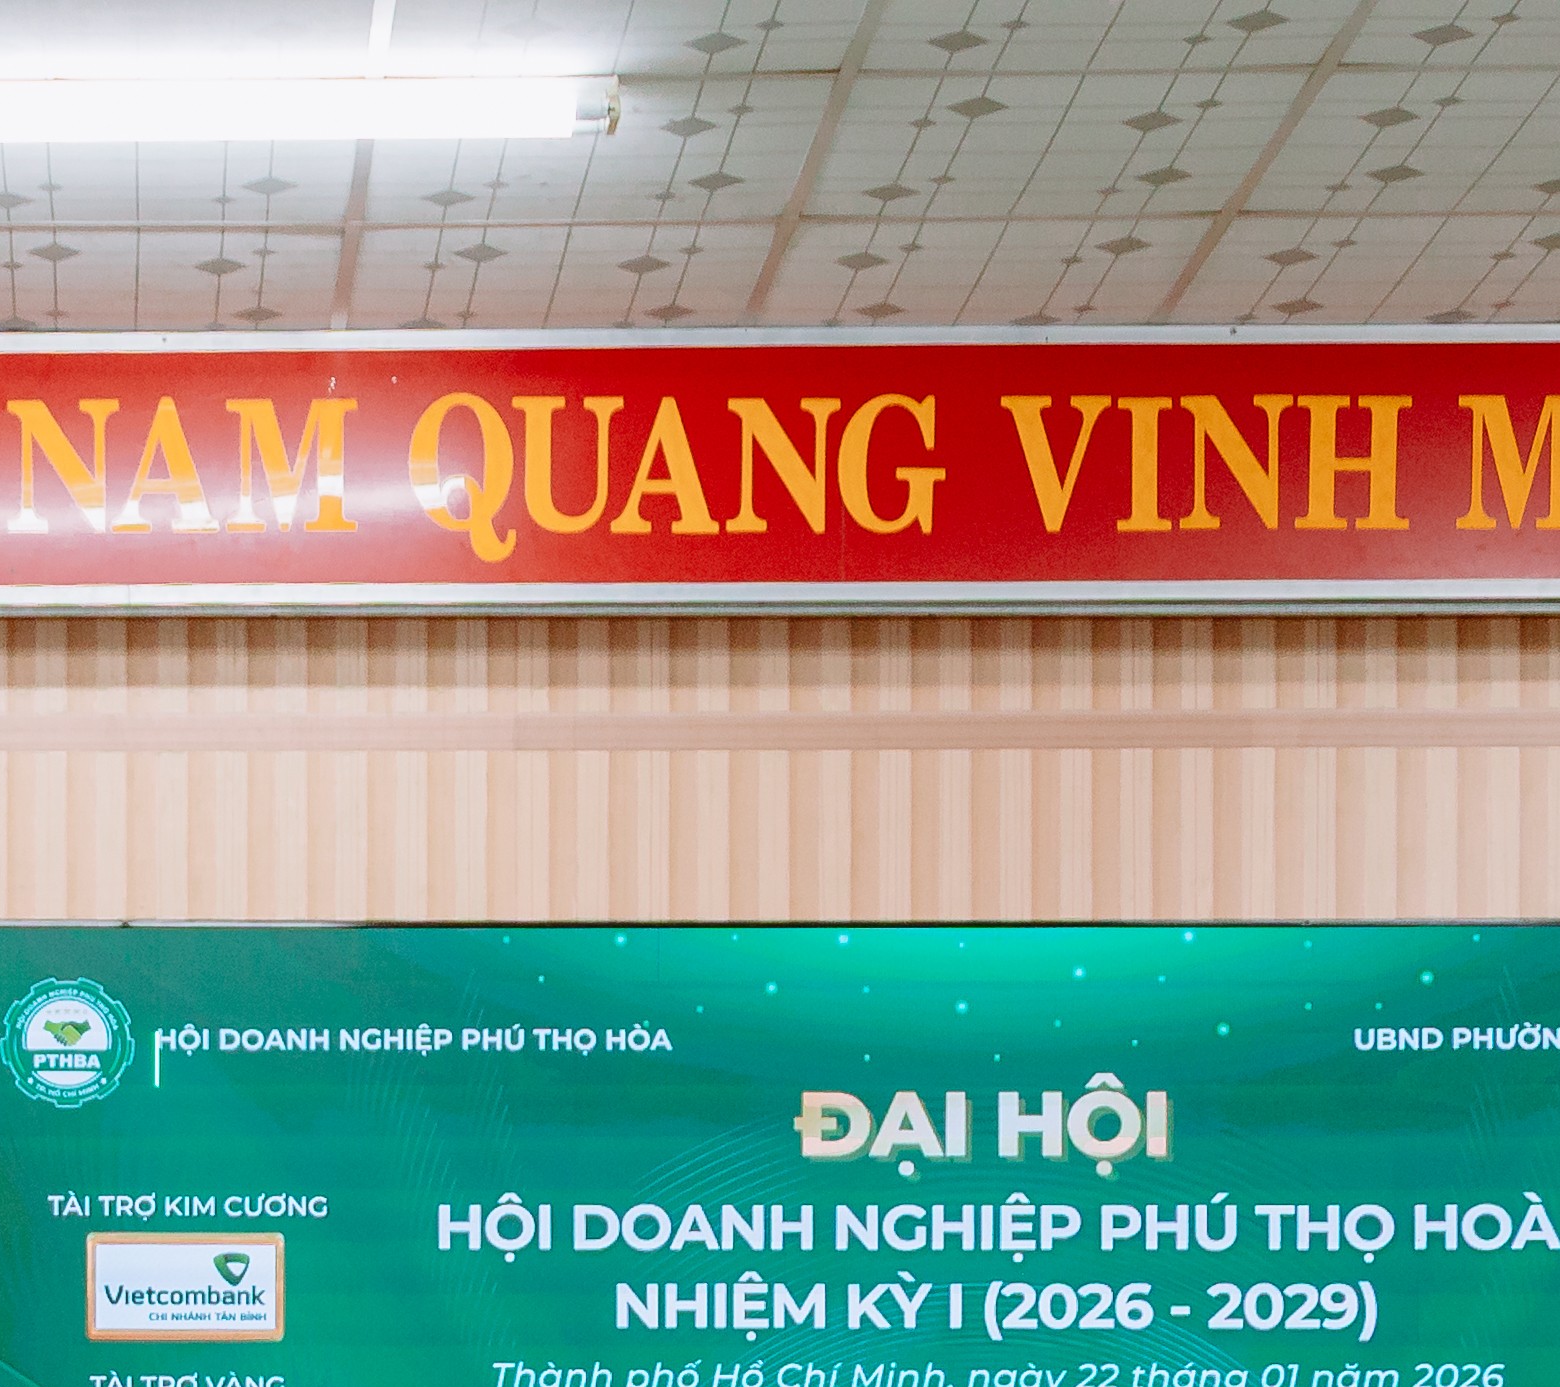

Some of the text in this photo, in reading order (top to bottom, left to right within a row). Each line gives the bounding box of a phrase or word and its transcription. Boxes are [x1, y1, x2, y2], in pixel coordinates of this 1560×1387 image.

[6, 397, 358, 536] NAM
[414, 393, 947, 563] QUANG
[1000, 394, 1410, 534] VINH
[158, 1020, 673, 1057] HỘI DOANH NGHIỆP PHÚ THỌ HÒA
[1354, 1027, 1444, 1051] UBND
[32, 1053, 101, 1069] PTHBA
[793, 1072, 1169, 1177] ĐẠI HỘI
[47, 1190, 328, 1223] TÀI TRỢ KIM CƯƠNG
[437, 1191, 552, 1263] HỘI
[573, 1203, 814, 1252] DOANH
[835, 1191, 1082, 1263] NGHIỆP
[1100, 1192, 1238, 1252] PHÚ
[1254, 1204, 1395, 1264] THỌ
[104, 1284, 266, 1306] Vietcombank
[615, 1270, 1378, 1343] NHIỆM KỲ I (2026 - 2029)
